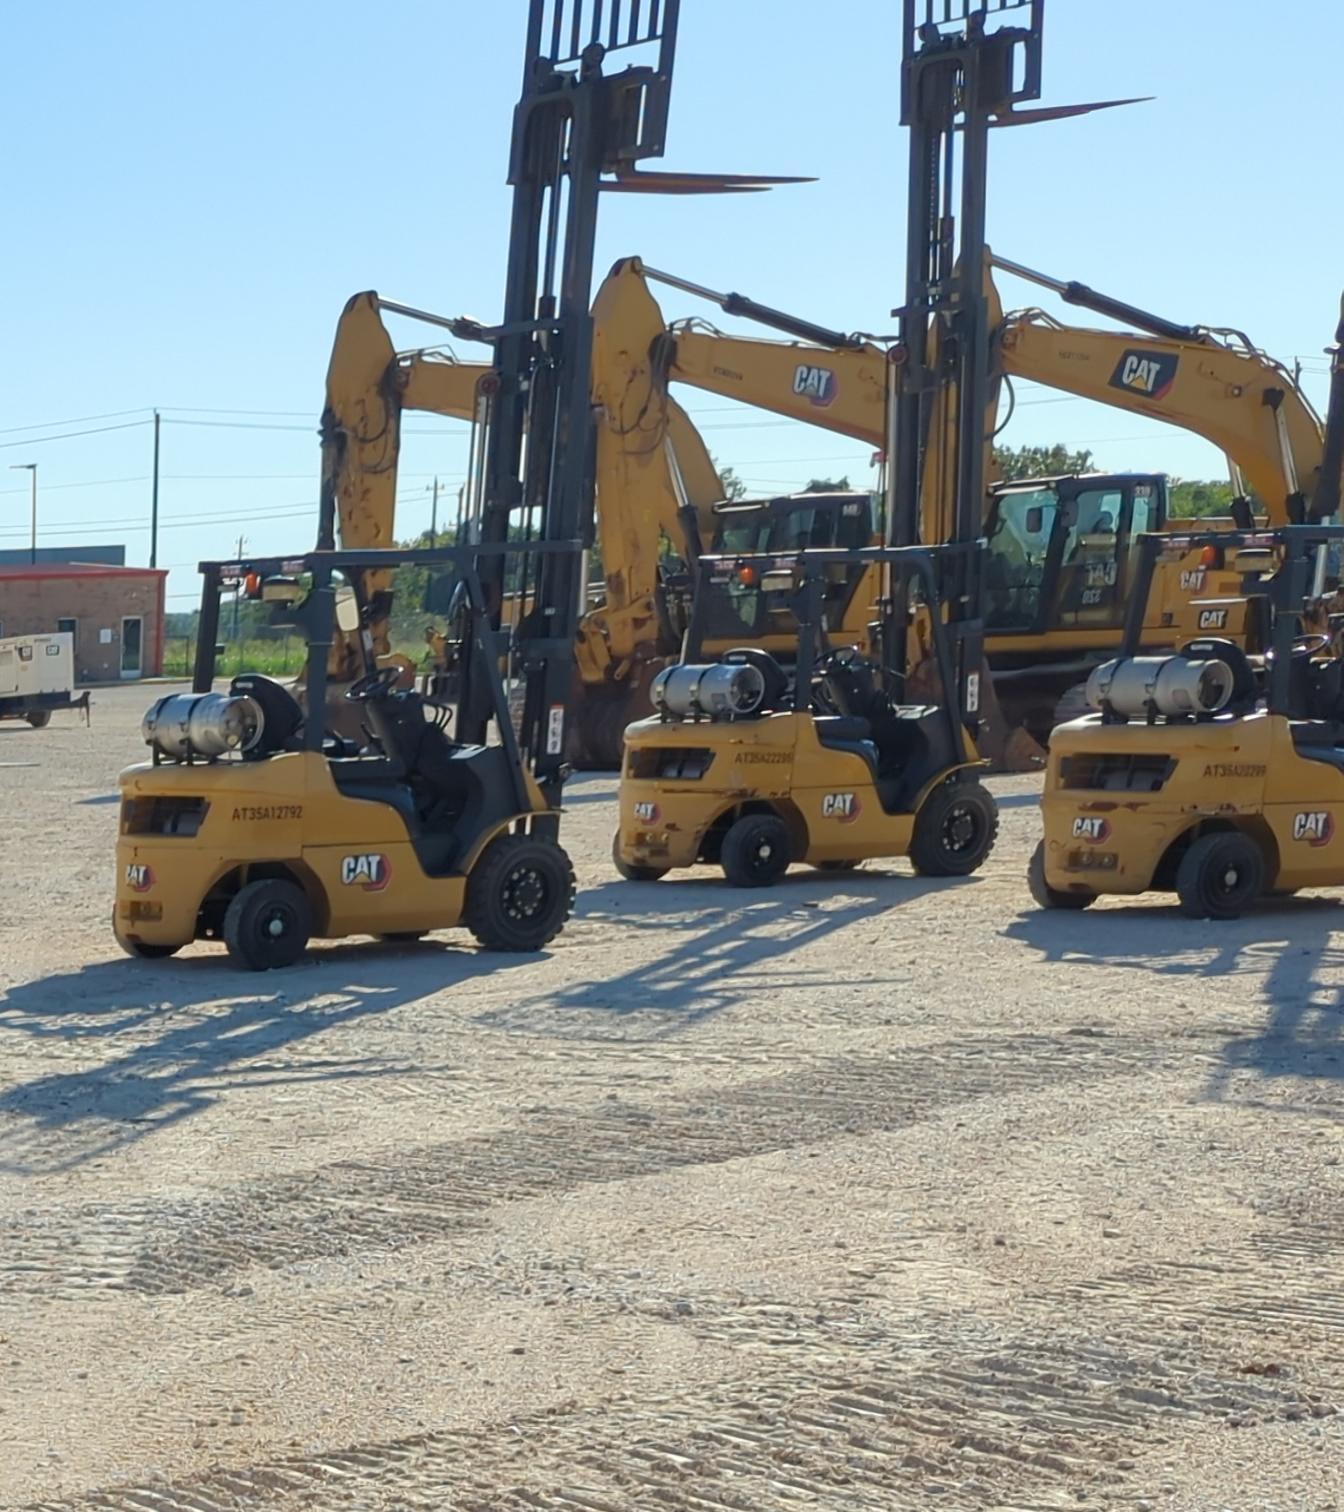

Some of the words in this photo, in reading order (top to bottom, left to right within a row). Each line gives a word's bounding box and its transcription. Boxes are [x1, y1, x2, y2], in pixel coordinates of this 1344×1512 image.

[794, 365, 831, 397] CAT
[1122, 355, 1161, 392] CAT
[1180, 569, 1204, 590] CAT
[1200, 610, 1226, 629] CAT
[823, 794, 854, 817] CAT
[1073, 818, 1102, 838] CAT
[1294, 812, 1327, 840] CAT
[343, 854, 382, 885] CAT
